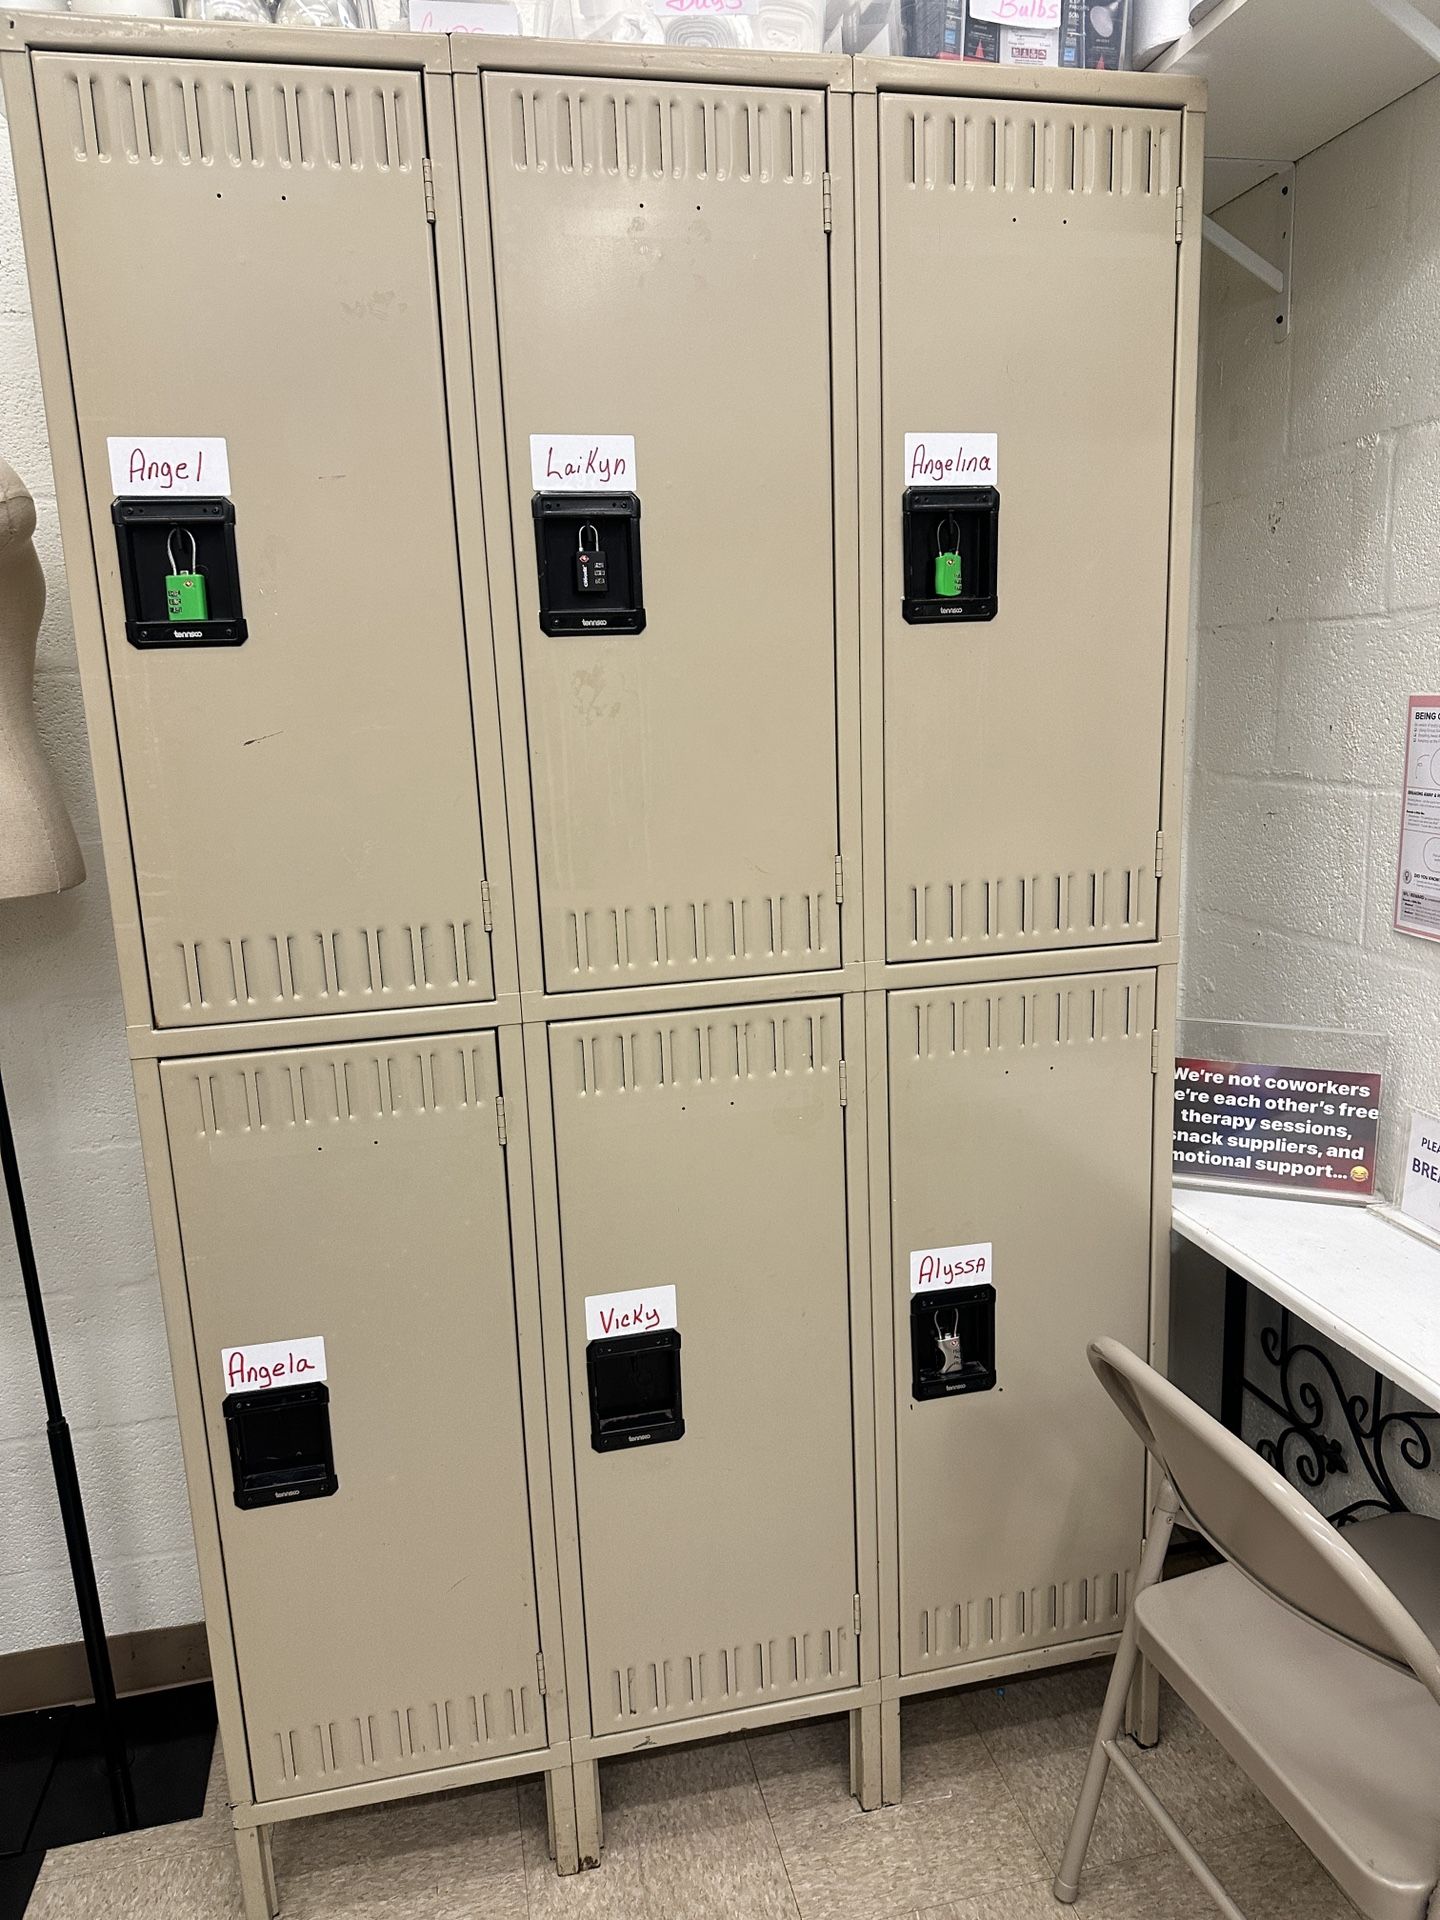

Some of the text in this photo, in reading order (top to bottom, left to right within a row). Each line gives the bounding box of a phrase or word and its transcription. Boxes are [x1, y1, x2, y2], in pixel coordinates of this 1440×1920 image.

[992, 0, 1058, 18] Bulbs
[129, 447, 203, 489] Angel
[911, 444, 992, 481] Angelina
[1415, 711, 1436, 720] BEING
[1174, 1067, 1371, 1097] We're not coworkers
[1174, 1088, 1379, 1120] e're each other's free
[1181, 1109, 1352, 1141] therapy sessions,
[1227, 1135, 1323, 1158] suppliers,
[1326, 1146, 1364, 1160] and
[1255, 1159, 1348, 1180] support...
[1412, 1157, 1440, 1183] BRE
[228, 1351, 316, 1388] Angela
